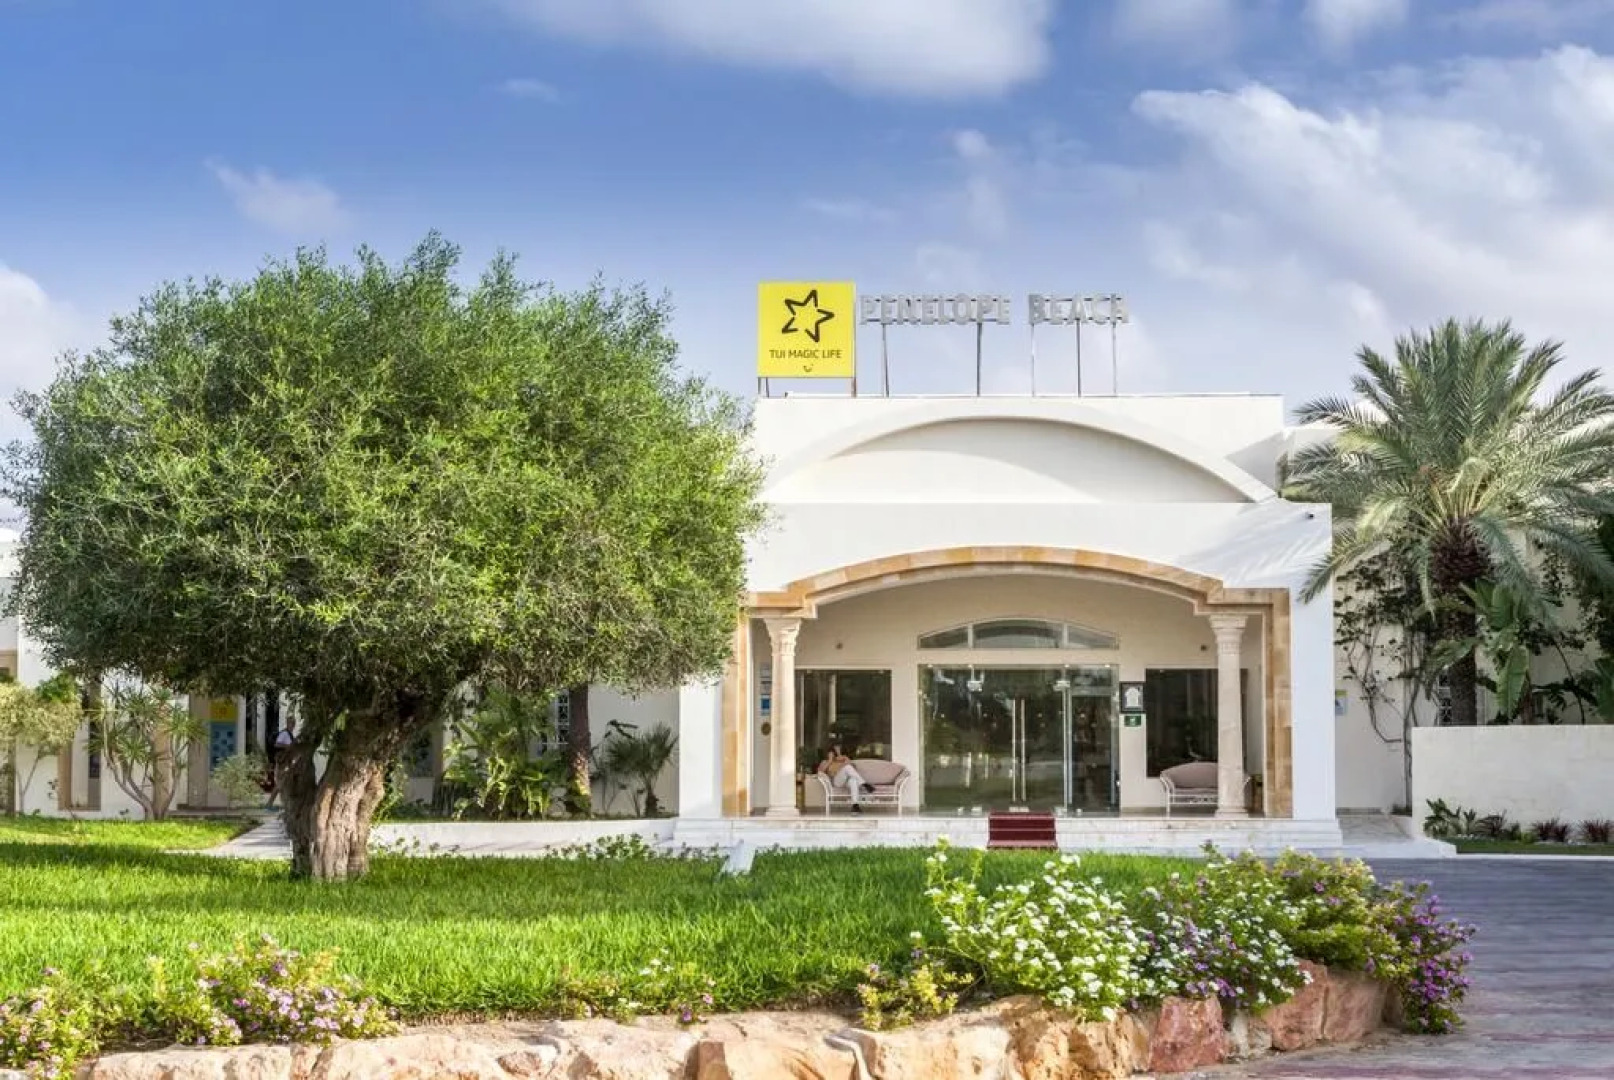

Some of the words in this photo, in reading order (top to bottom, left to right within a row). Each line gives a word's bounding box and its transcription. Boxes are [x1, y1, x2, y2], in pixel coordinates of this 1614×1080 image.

[860, 293, 1010, 325] PENELOPE
[1028, 293, 1129, 325] BEACH
[769, 349, 786, 359] TUI
[788, 349, 819, 359] MAGIC
[822, 349, 842, 359] LIFE
